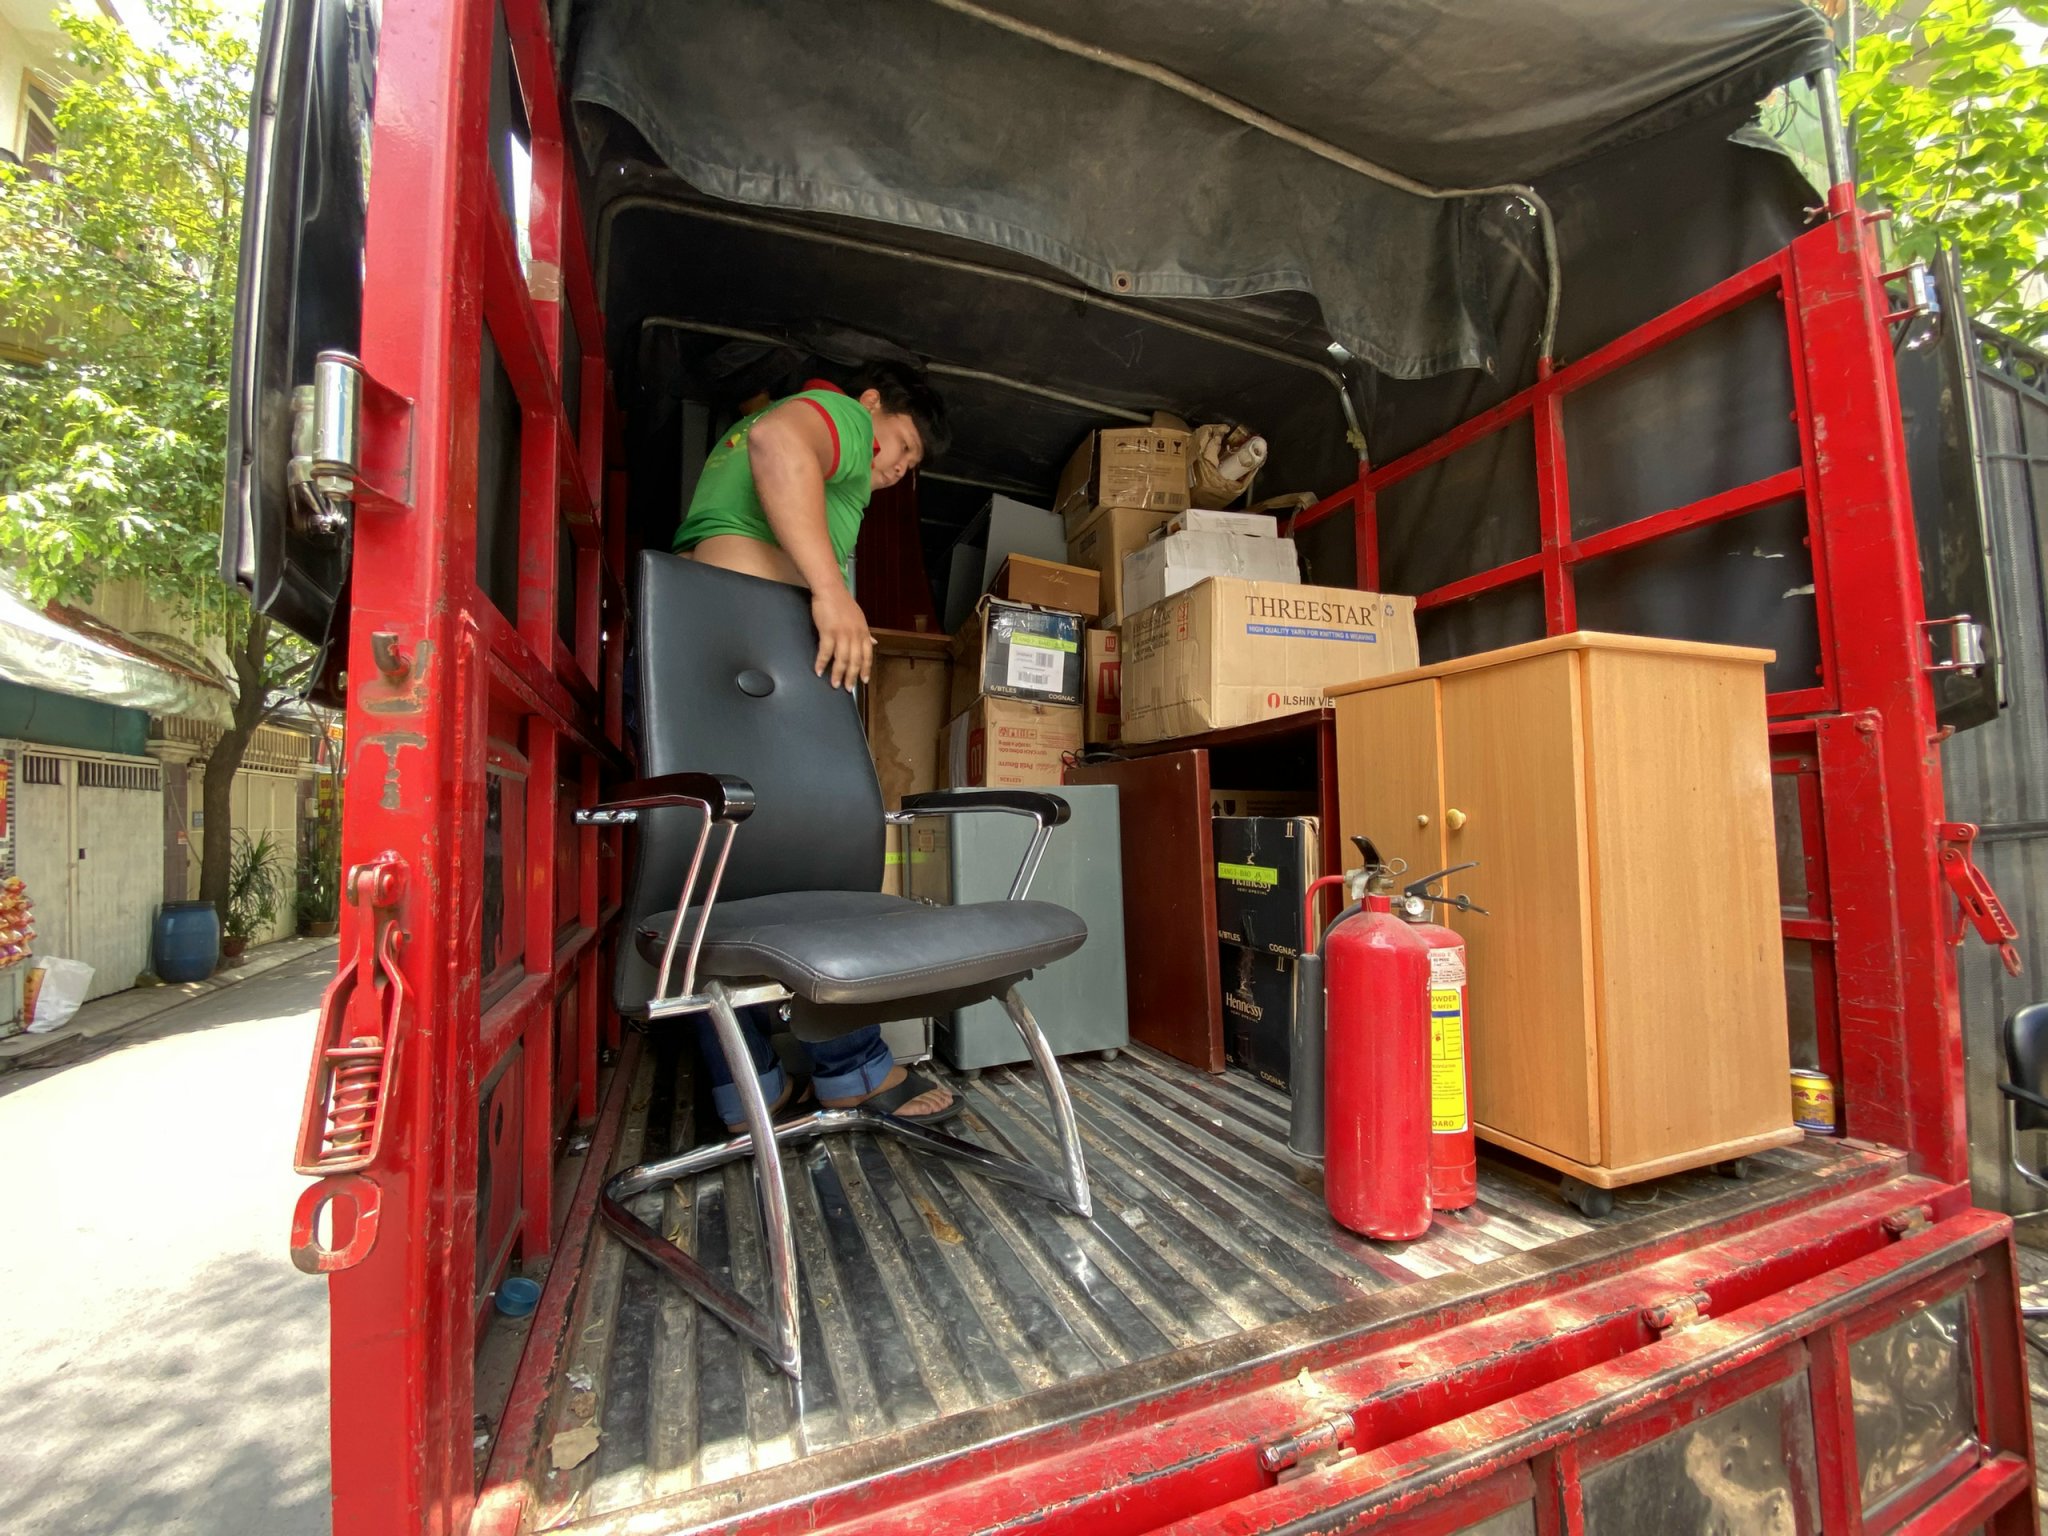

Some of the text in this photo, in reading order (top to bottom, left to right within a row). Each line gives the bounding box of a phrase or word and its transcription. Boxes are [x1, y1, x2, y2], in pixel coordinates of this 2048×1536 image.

[1245, 596, 1375, 626] THREESTAR
[1248, 625, 1264, 633] HIGH
[1265, 626, 1289, 635] QUALITY
[1307, 629, 1319, 637] FOR
[1320, 630, 1345, 639] KNITTING
[1350, 633, 1375, 641] WEAVING
[1048, 693, 1075, 702] COGNAC
[1283, 695, 1334, 707] ILSHIN VIE
[1268, 943, 1297, 957] COGNAC
[1225, 991, 1264, 1021] Hennessy
[1260, 1071, 1287, 1089] COGNAC
